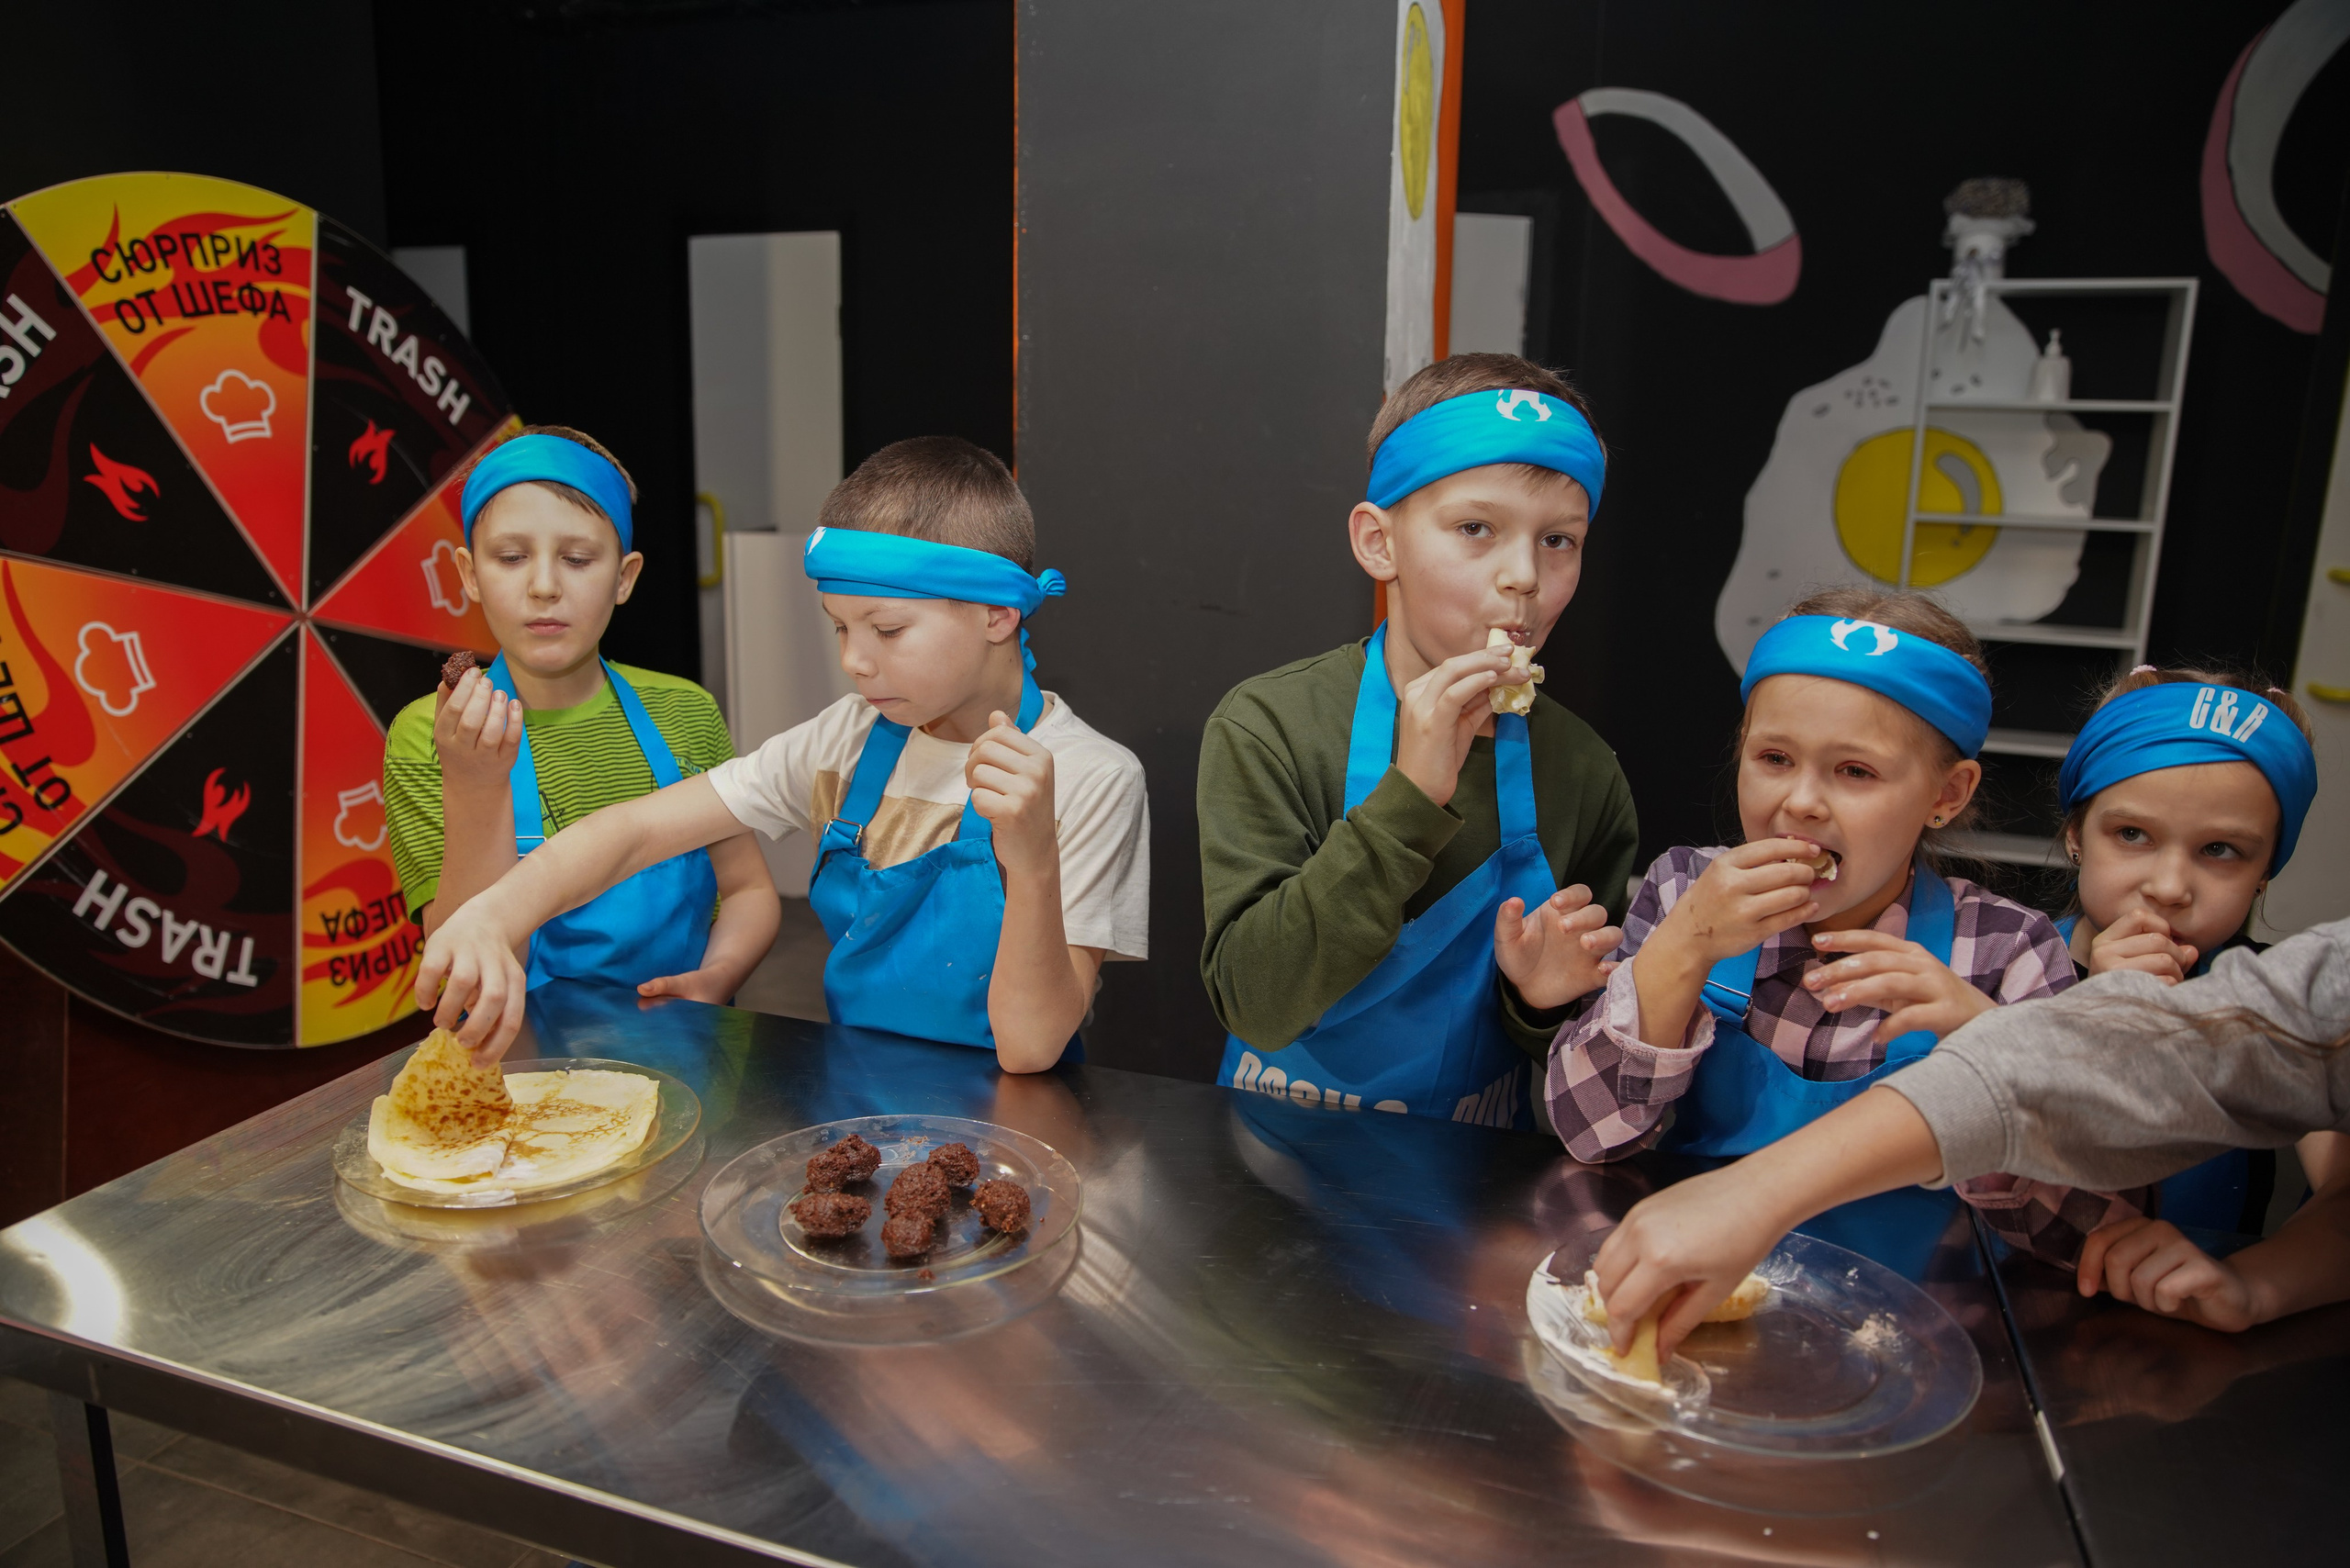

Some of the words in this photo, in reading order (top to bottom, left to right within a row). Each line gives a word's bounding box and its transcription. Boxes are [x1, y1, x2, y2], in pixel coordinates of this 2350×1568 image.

[91, 233, 283, 283] СЮРПРИЗ
[114, 289, 165, 335] ОТ
[172, 281, 292, 323] ШЕФА
[346, 286, 471, 425] TRASH
[11, 756, 72, 812] ОТ
[72, 869, 259, 988] TRASH
